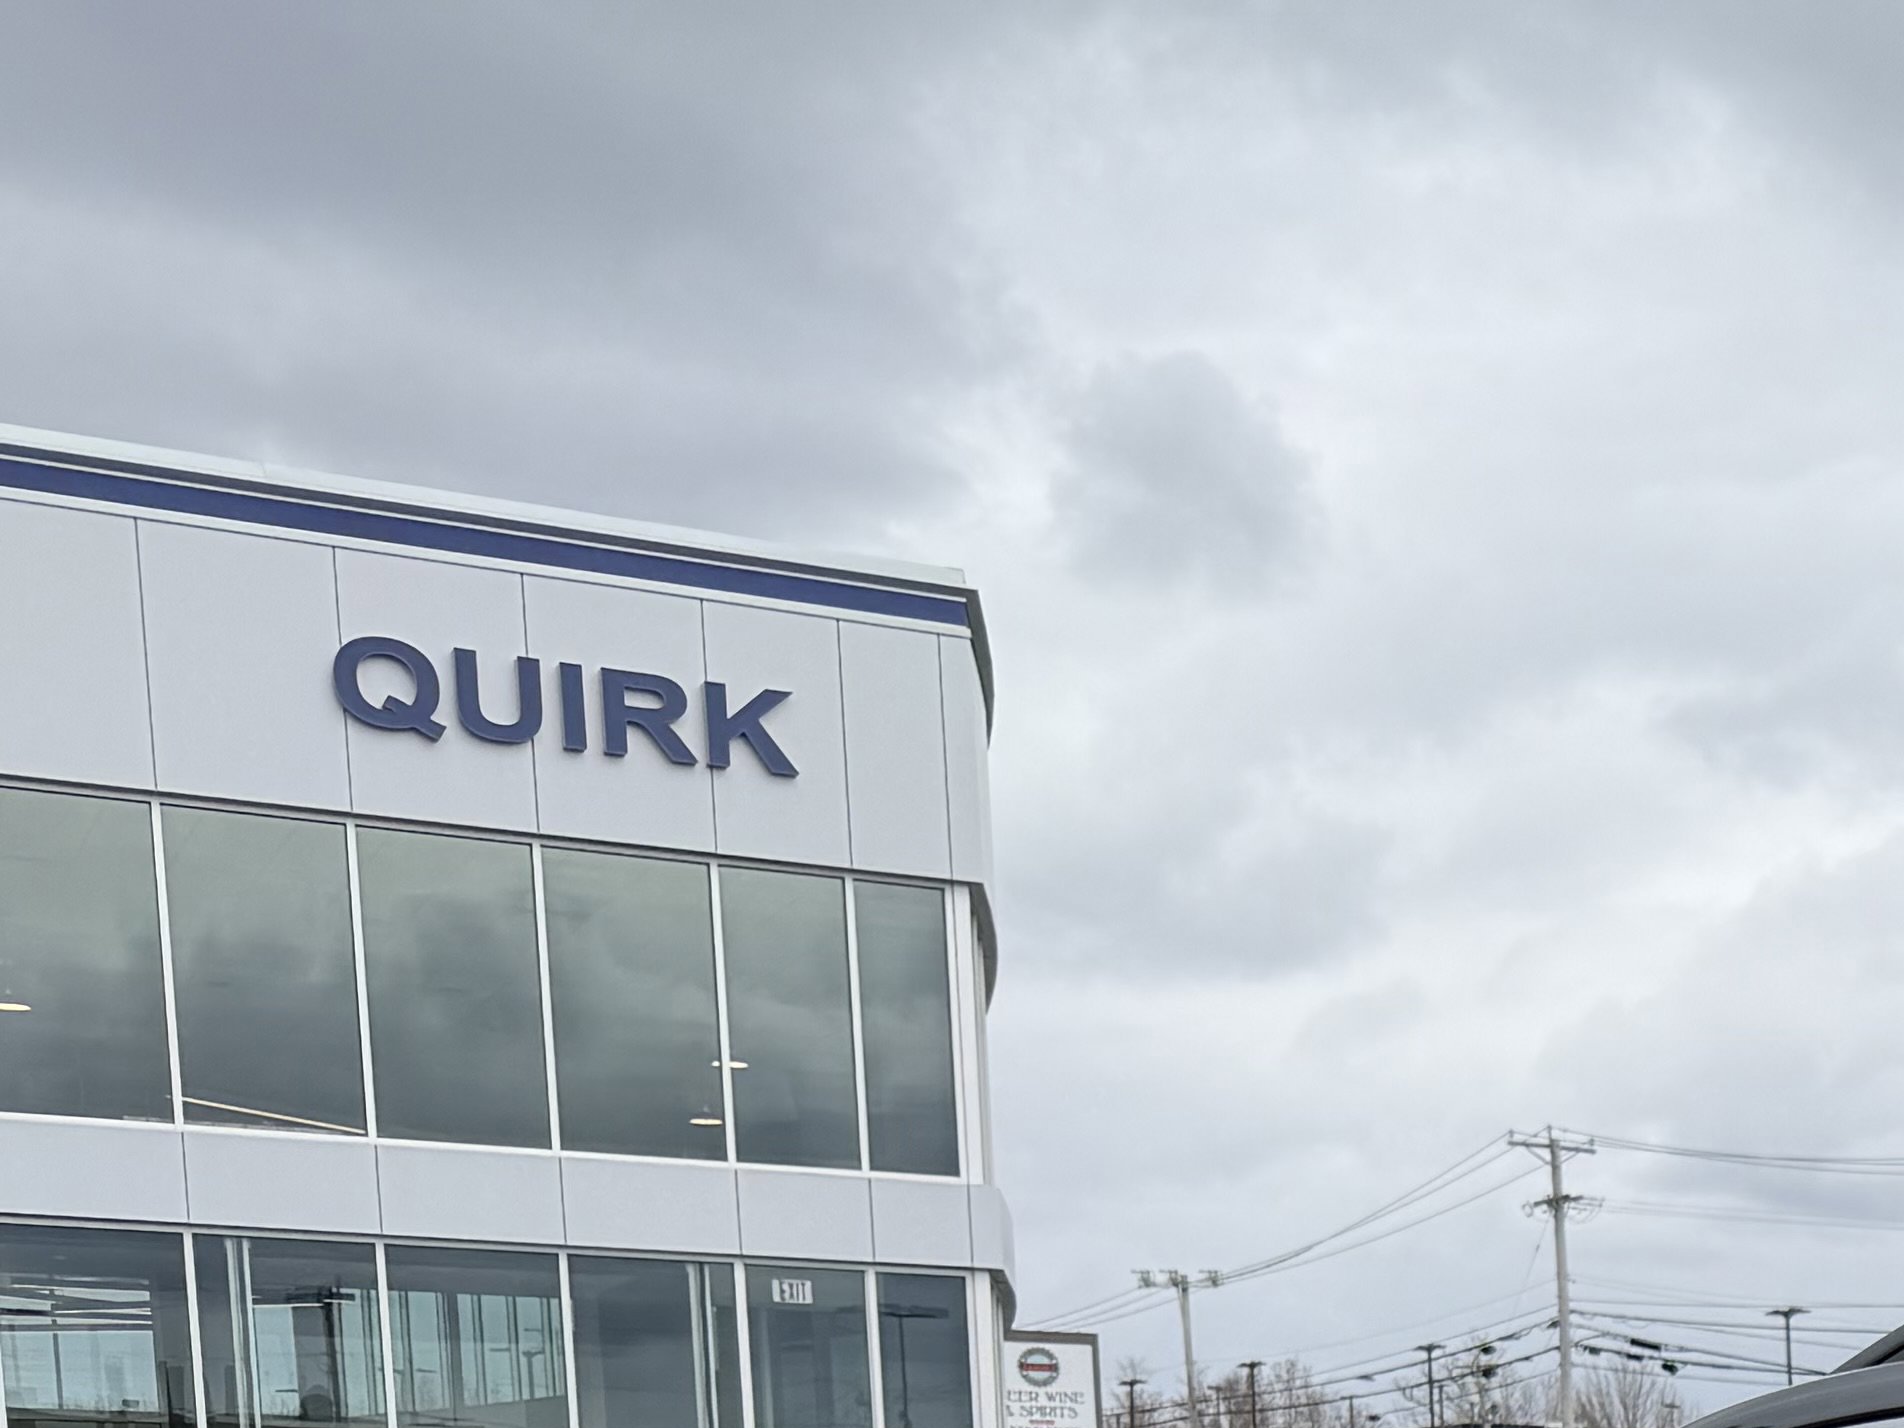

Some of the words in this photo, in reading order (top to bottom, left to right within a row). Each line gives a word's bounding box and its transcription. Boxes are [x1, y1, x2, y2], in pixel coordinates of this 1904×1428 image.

[332, 634, 799, 778] QUIRK
[779, 1281, 806, 1302] EXIT
[1007, 1391, 1039, 1402] EER
[1045, 1391, 1085, 1404] WINE
[1019, 1405, 1078, 1419] SPIRITS
